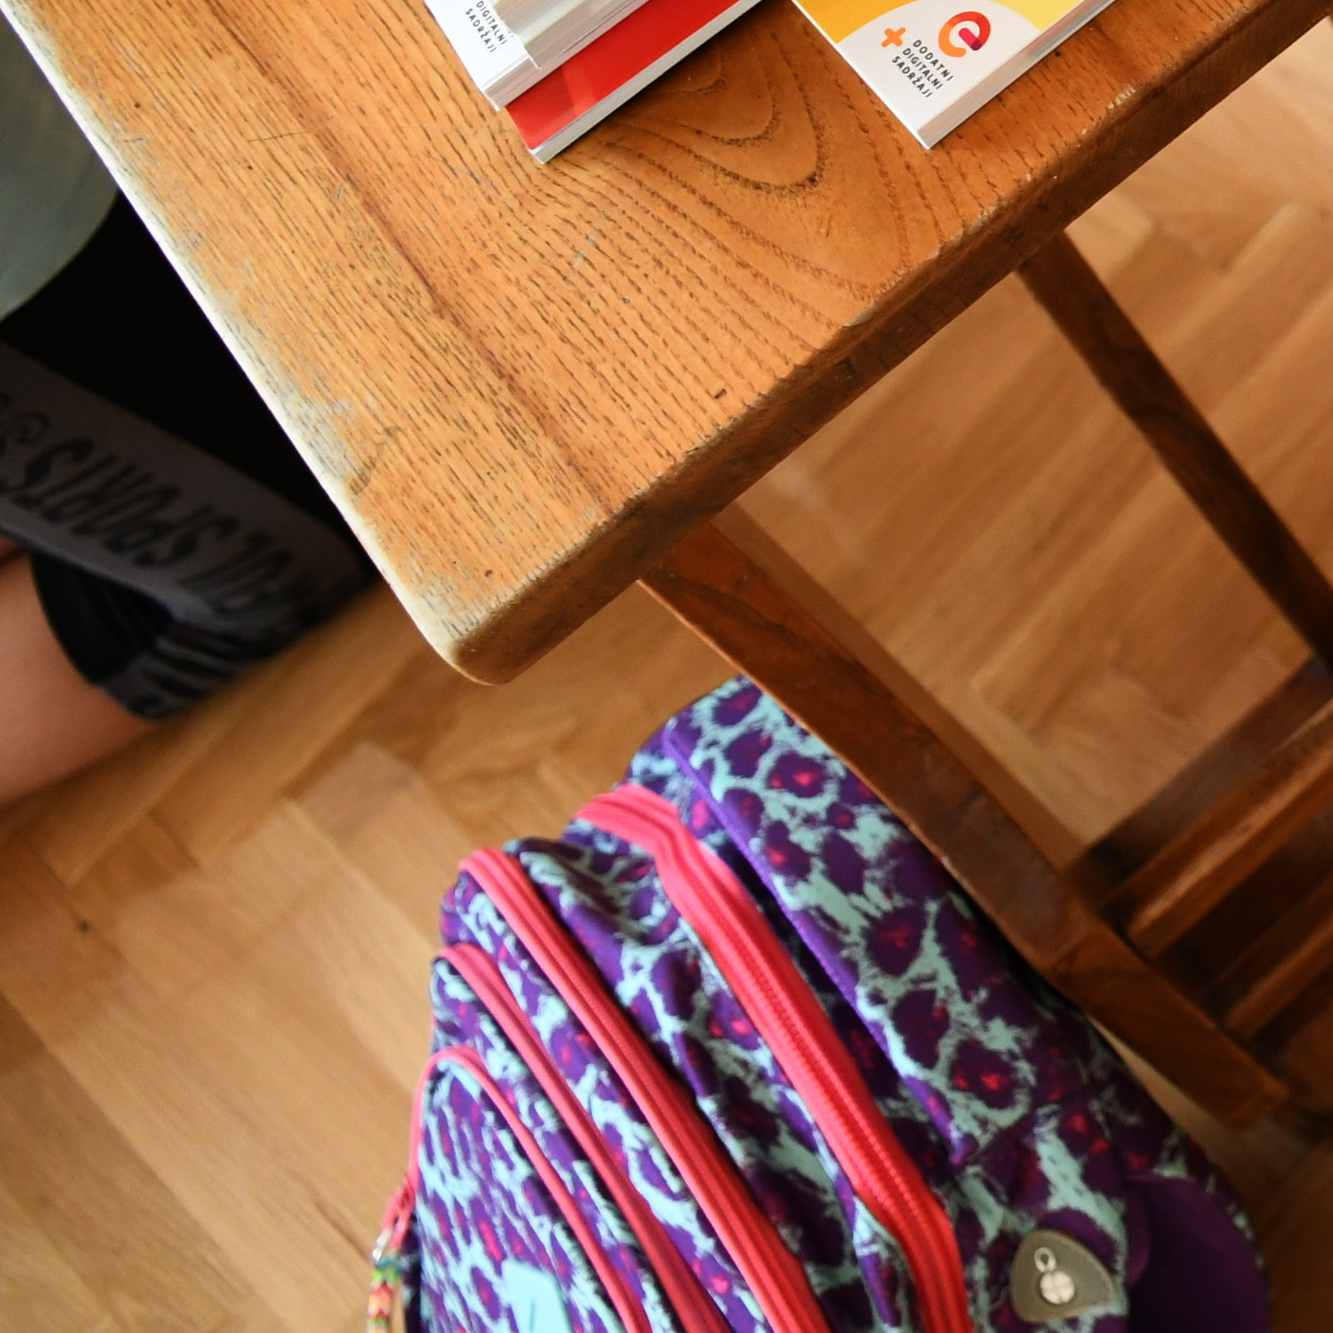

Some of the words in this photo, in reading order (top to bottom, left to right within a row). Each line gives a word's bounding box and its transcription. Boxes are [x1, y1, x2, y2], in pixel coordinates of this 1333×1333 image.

[464, 8, 496, 53] SADRŽAJI
[475, 0, 507, 46] DIGITALNI
[892, 56, 933, 98] SADRŽAJI
[902, 48, 943, 90] DIGITALNI
[913, 40, 954, 81] DODATNI
